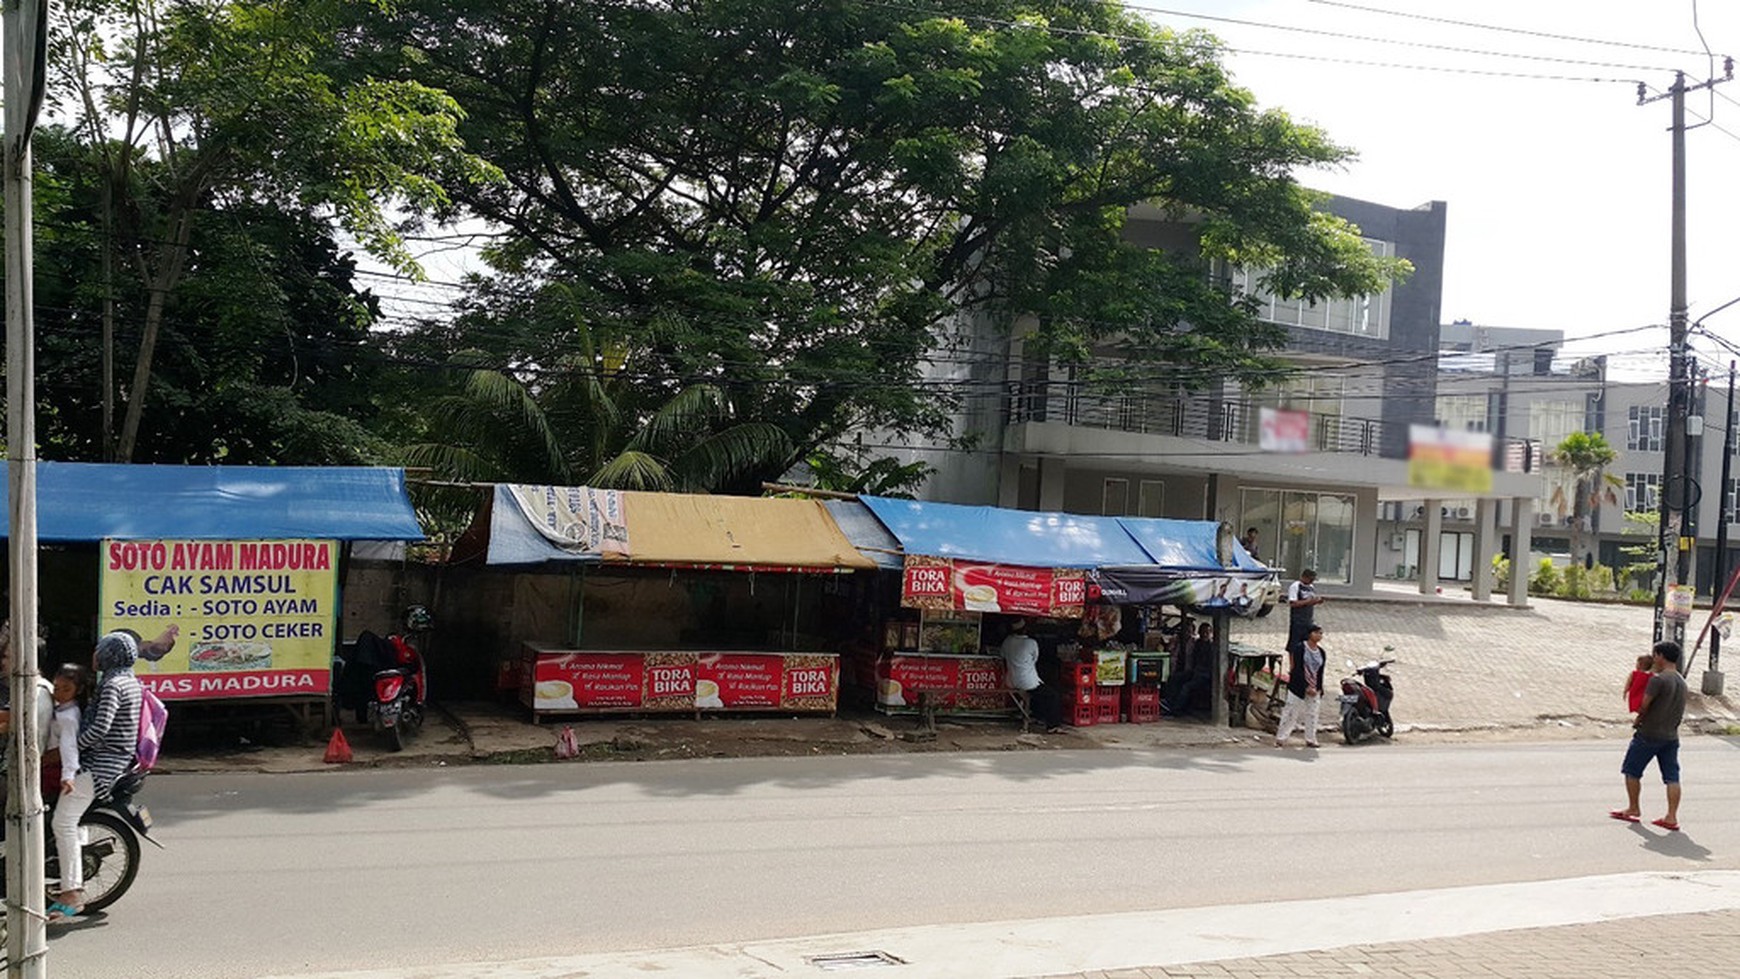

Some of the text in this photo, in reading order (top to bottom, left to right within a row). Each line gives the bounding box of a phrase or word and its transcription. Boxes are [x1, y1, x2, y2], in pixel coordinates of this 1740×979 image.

[109, 543, 330, 570] SOTO AYAM MADURA
[911, 568, 945, 581] TORA
[144, 575, 296, 595] CAK SAMSUL
[911, 580, 945, 593] BIKA
[114, 600, 171, 617] Sedia
[202, 599, 257, 616] SOTO
[262, 598, 318, 614] AYAM
[202, 624, 257, 640] SOTO
[262, 623, 323, 639] CEKER
[653, 669, 691, 681] TORA
[791, 670, 826, 682] TORA
[966, 672, 996, 682] TORA
[142, 674, 314, 694] HAS MADURA
[654, 681, 691, 693] BIKA
[793, 682, 826, 693] BIKA
